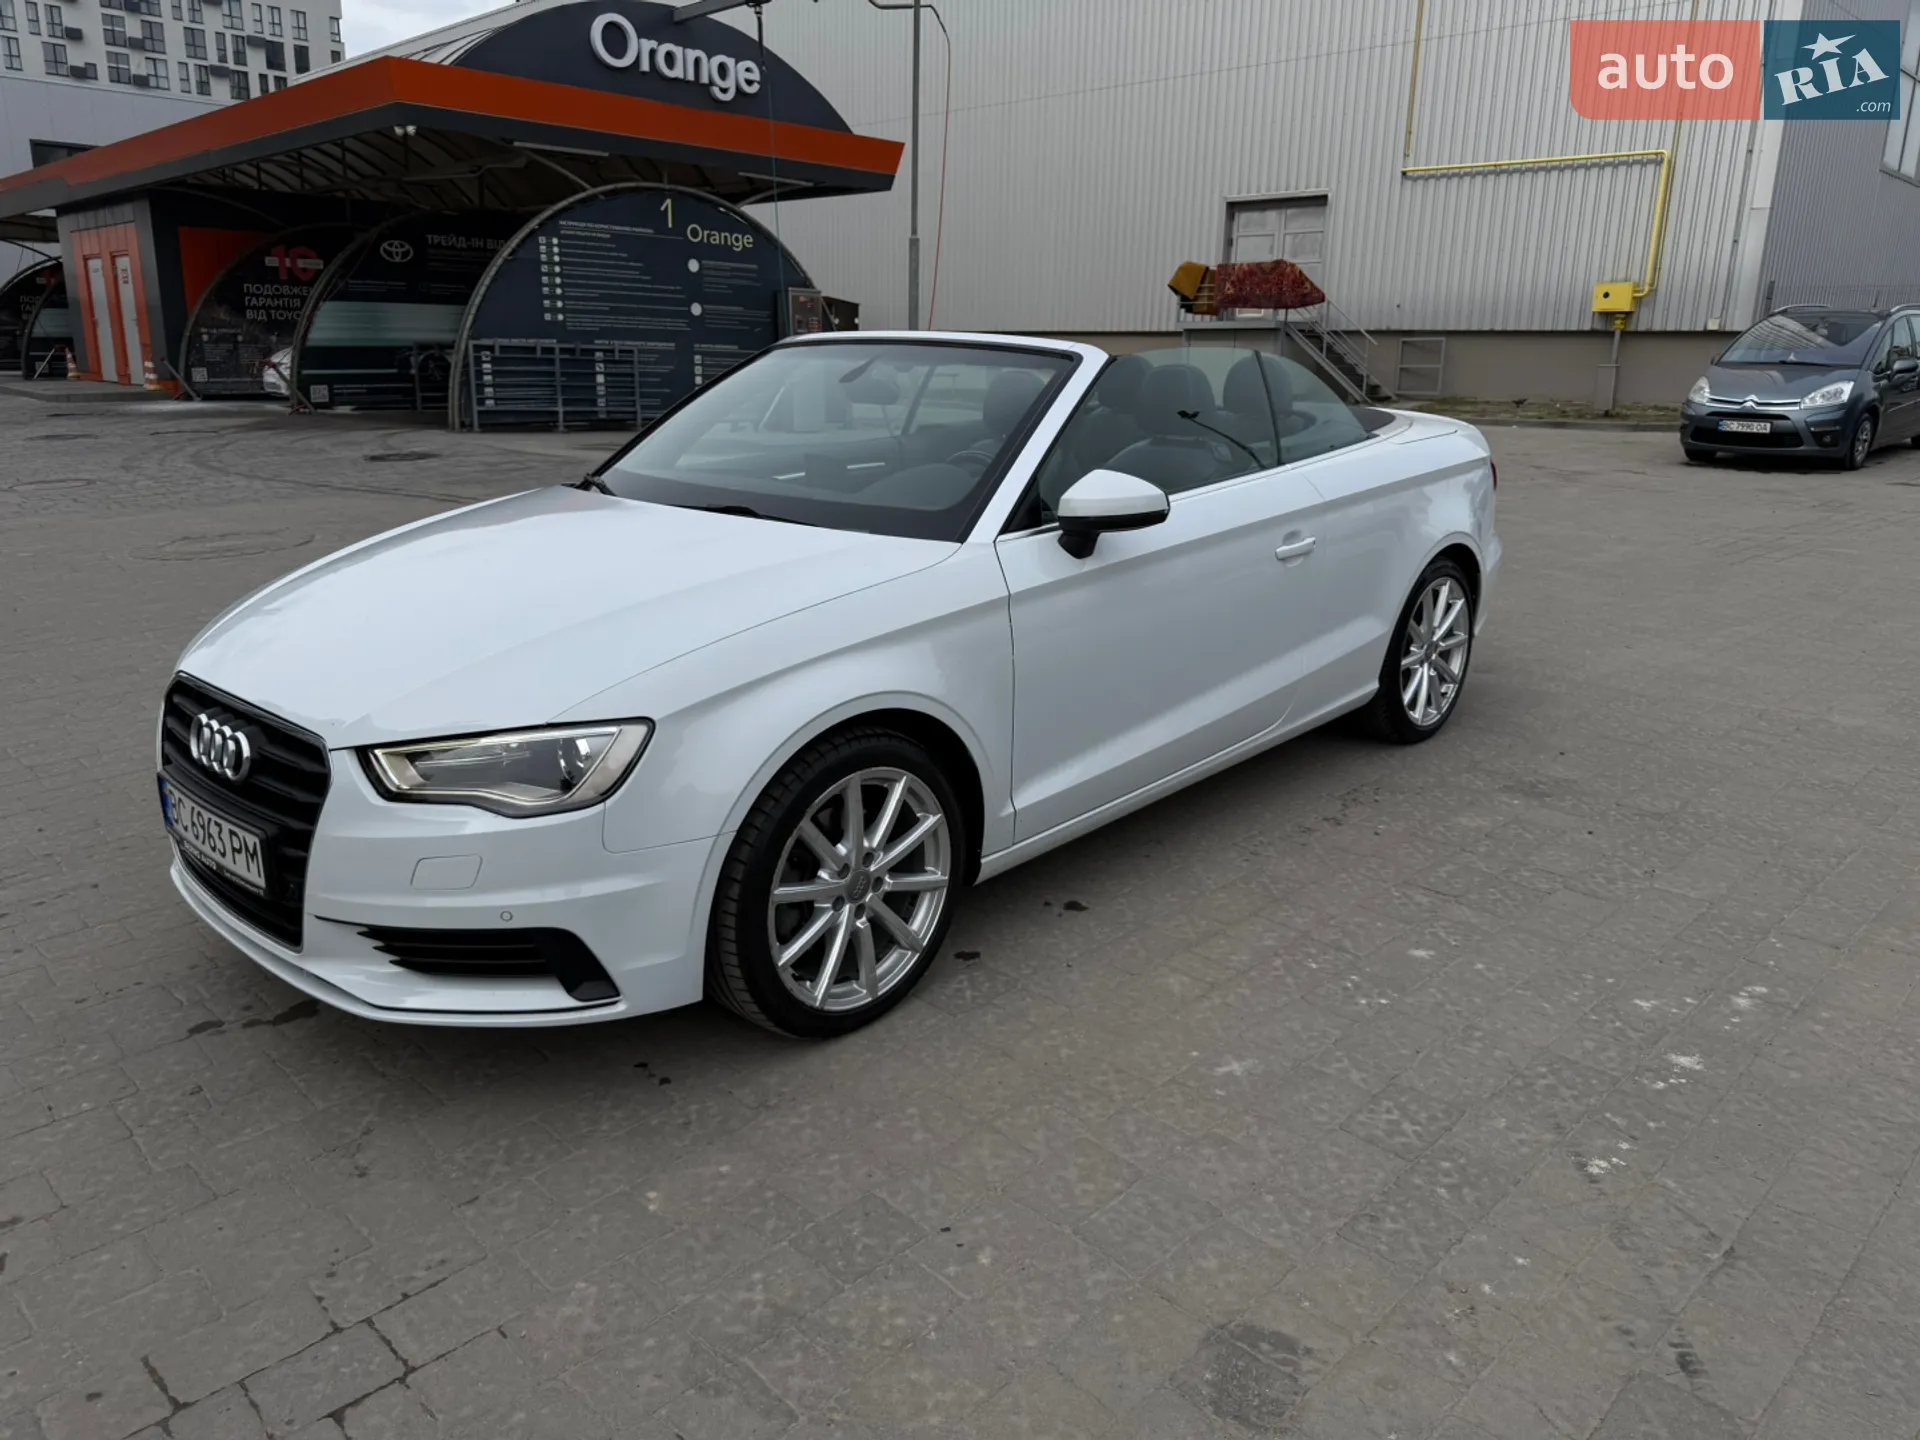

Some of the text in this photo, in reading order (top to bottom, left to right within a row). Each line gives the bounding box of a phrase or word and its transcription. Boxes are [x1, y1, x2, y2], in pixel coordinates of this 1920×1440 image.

[590, 12, 761, 101] Orange
[660, 198, 673, 228] 1
[686, 224, 754, 251] Orange
[245, 296, 301, 308] ГАРАНТІЯ
[246, 309, 267, 321] ВІД
[191, 806, 227, 859] 6963
[228, 828, 262, 878] PM
